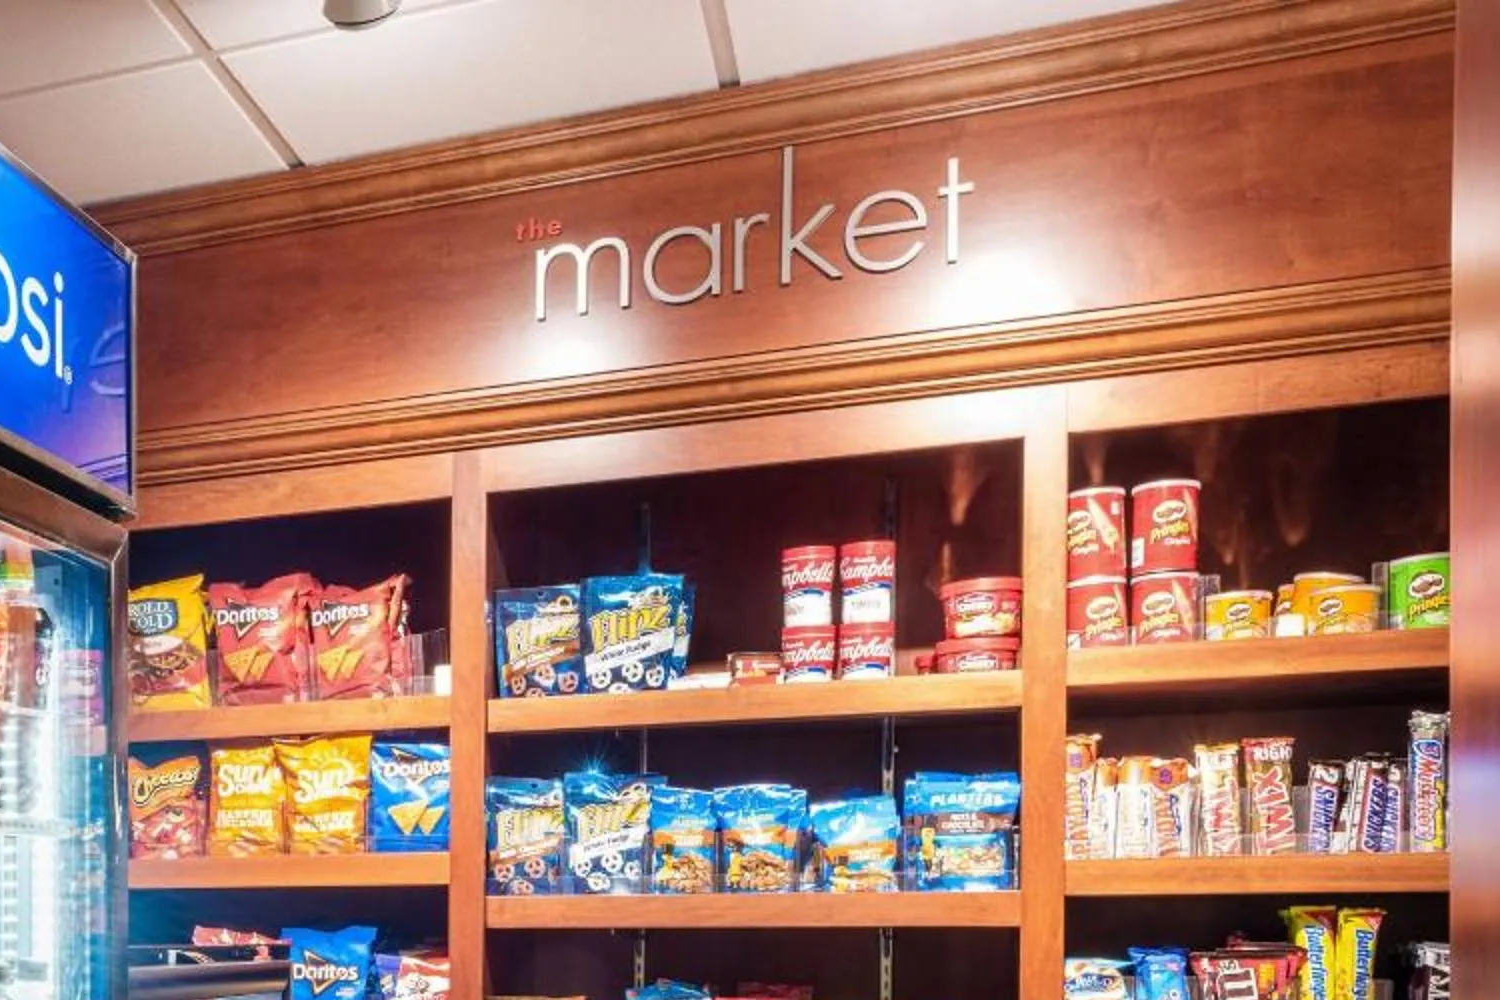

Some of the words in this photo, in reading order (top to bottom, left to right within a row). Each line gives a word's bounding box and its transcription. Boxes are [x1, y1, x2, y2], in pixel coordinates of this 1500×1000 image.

[514, 216, 563, 242] the
[534, 145, 975, 322] market
[216, 606, 279, 626] Doritos
[311, 603, 369, 628] Doritos
[1252, 745, 1293, 761] RIGH
[292, 963, 359, 981] Doritos
